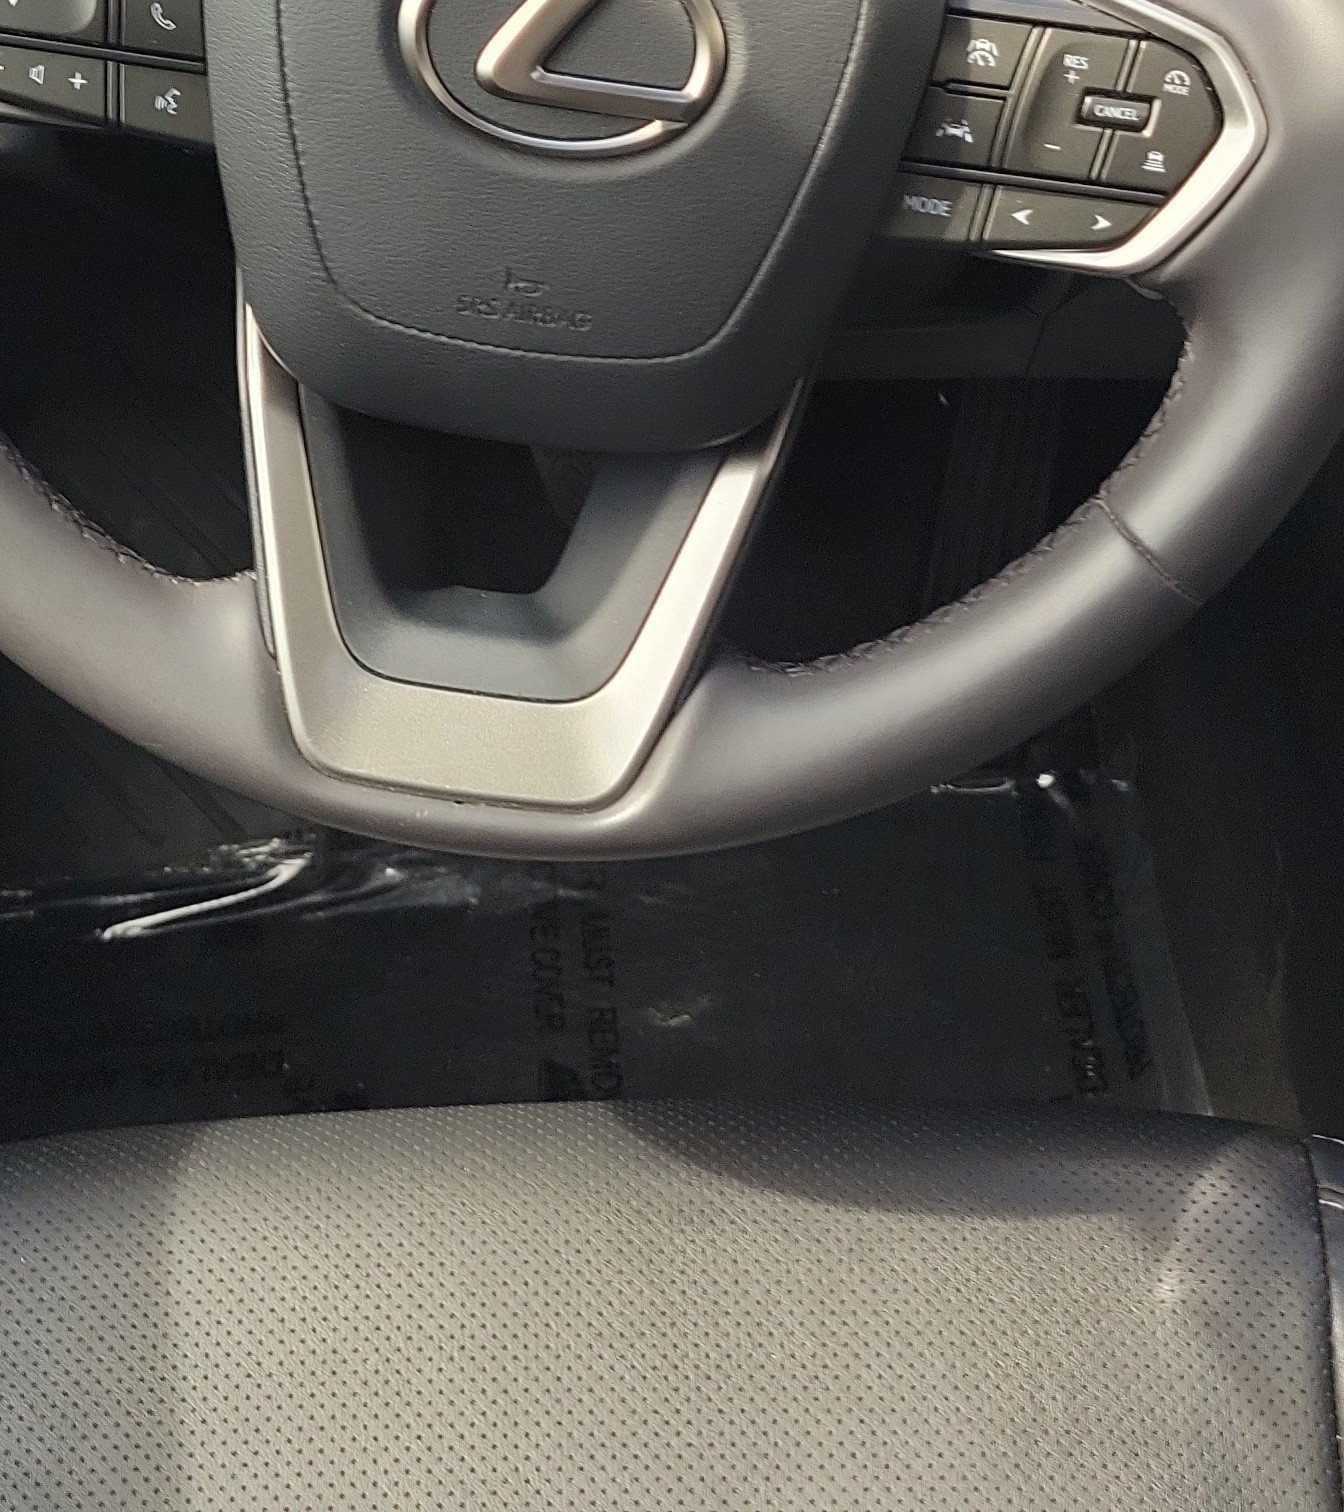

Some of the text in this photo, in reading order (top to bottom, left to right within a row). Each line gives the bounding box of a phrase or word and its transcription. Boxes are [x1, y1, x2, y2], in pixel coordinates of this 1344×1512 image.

[1062, 53, 1089, 70] RES
[1093, 103, 1143, 122] CANCEL
[903, 195, 953, 218] MODE
[588, 1006, 624, 1091] REMO
